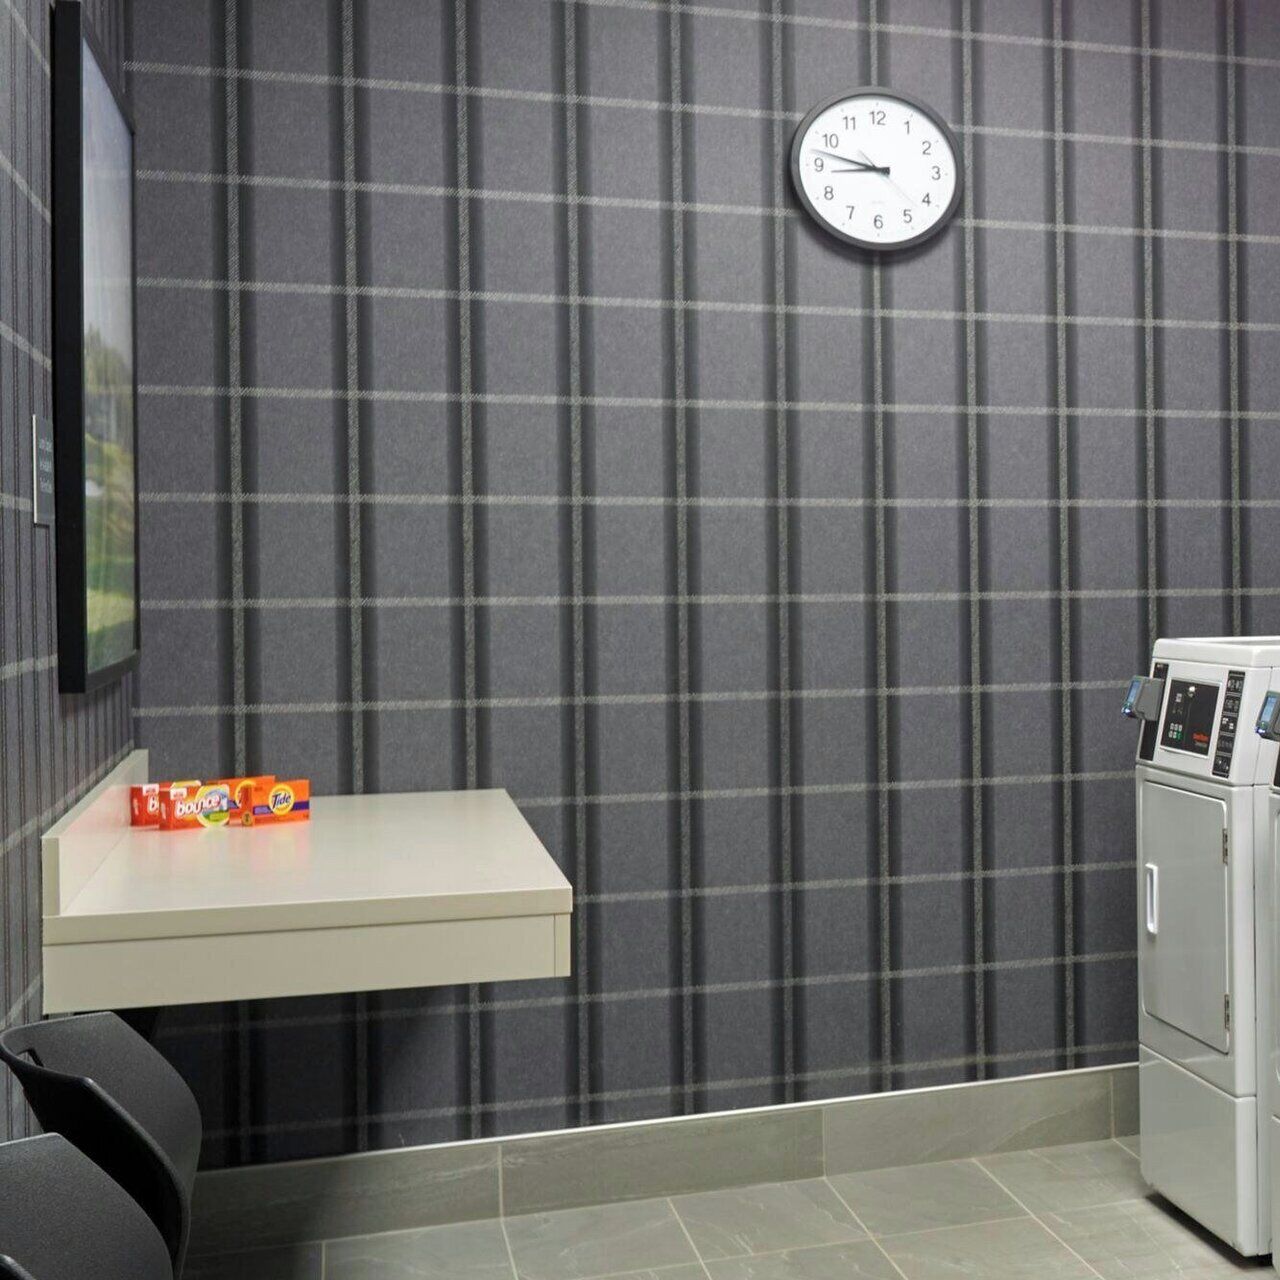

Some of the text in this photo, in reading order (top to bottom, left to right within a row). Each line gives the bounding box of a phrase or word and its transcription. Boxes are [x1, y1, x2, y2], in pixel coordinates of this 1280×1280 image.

[843, 116, 856, 130] 11
[869, 110, 886, 126] 12
[904, 120, 910, 135] 1
[822, 134, 838, 149] 10
[922, 140, 932, 156] 2
[814, 158, 824, 172] 9
[932, 166, 941, 180] 3
[824, 186, 834, 200] 8
[922, 192, 931, 207] 4
[846, 206, 854, 220] 7
[904, 210, 912, 224] 5
[874, 215, 884, 230] 6
[272, 793, 291, 810] Tide
